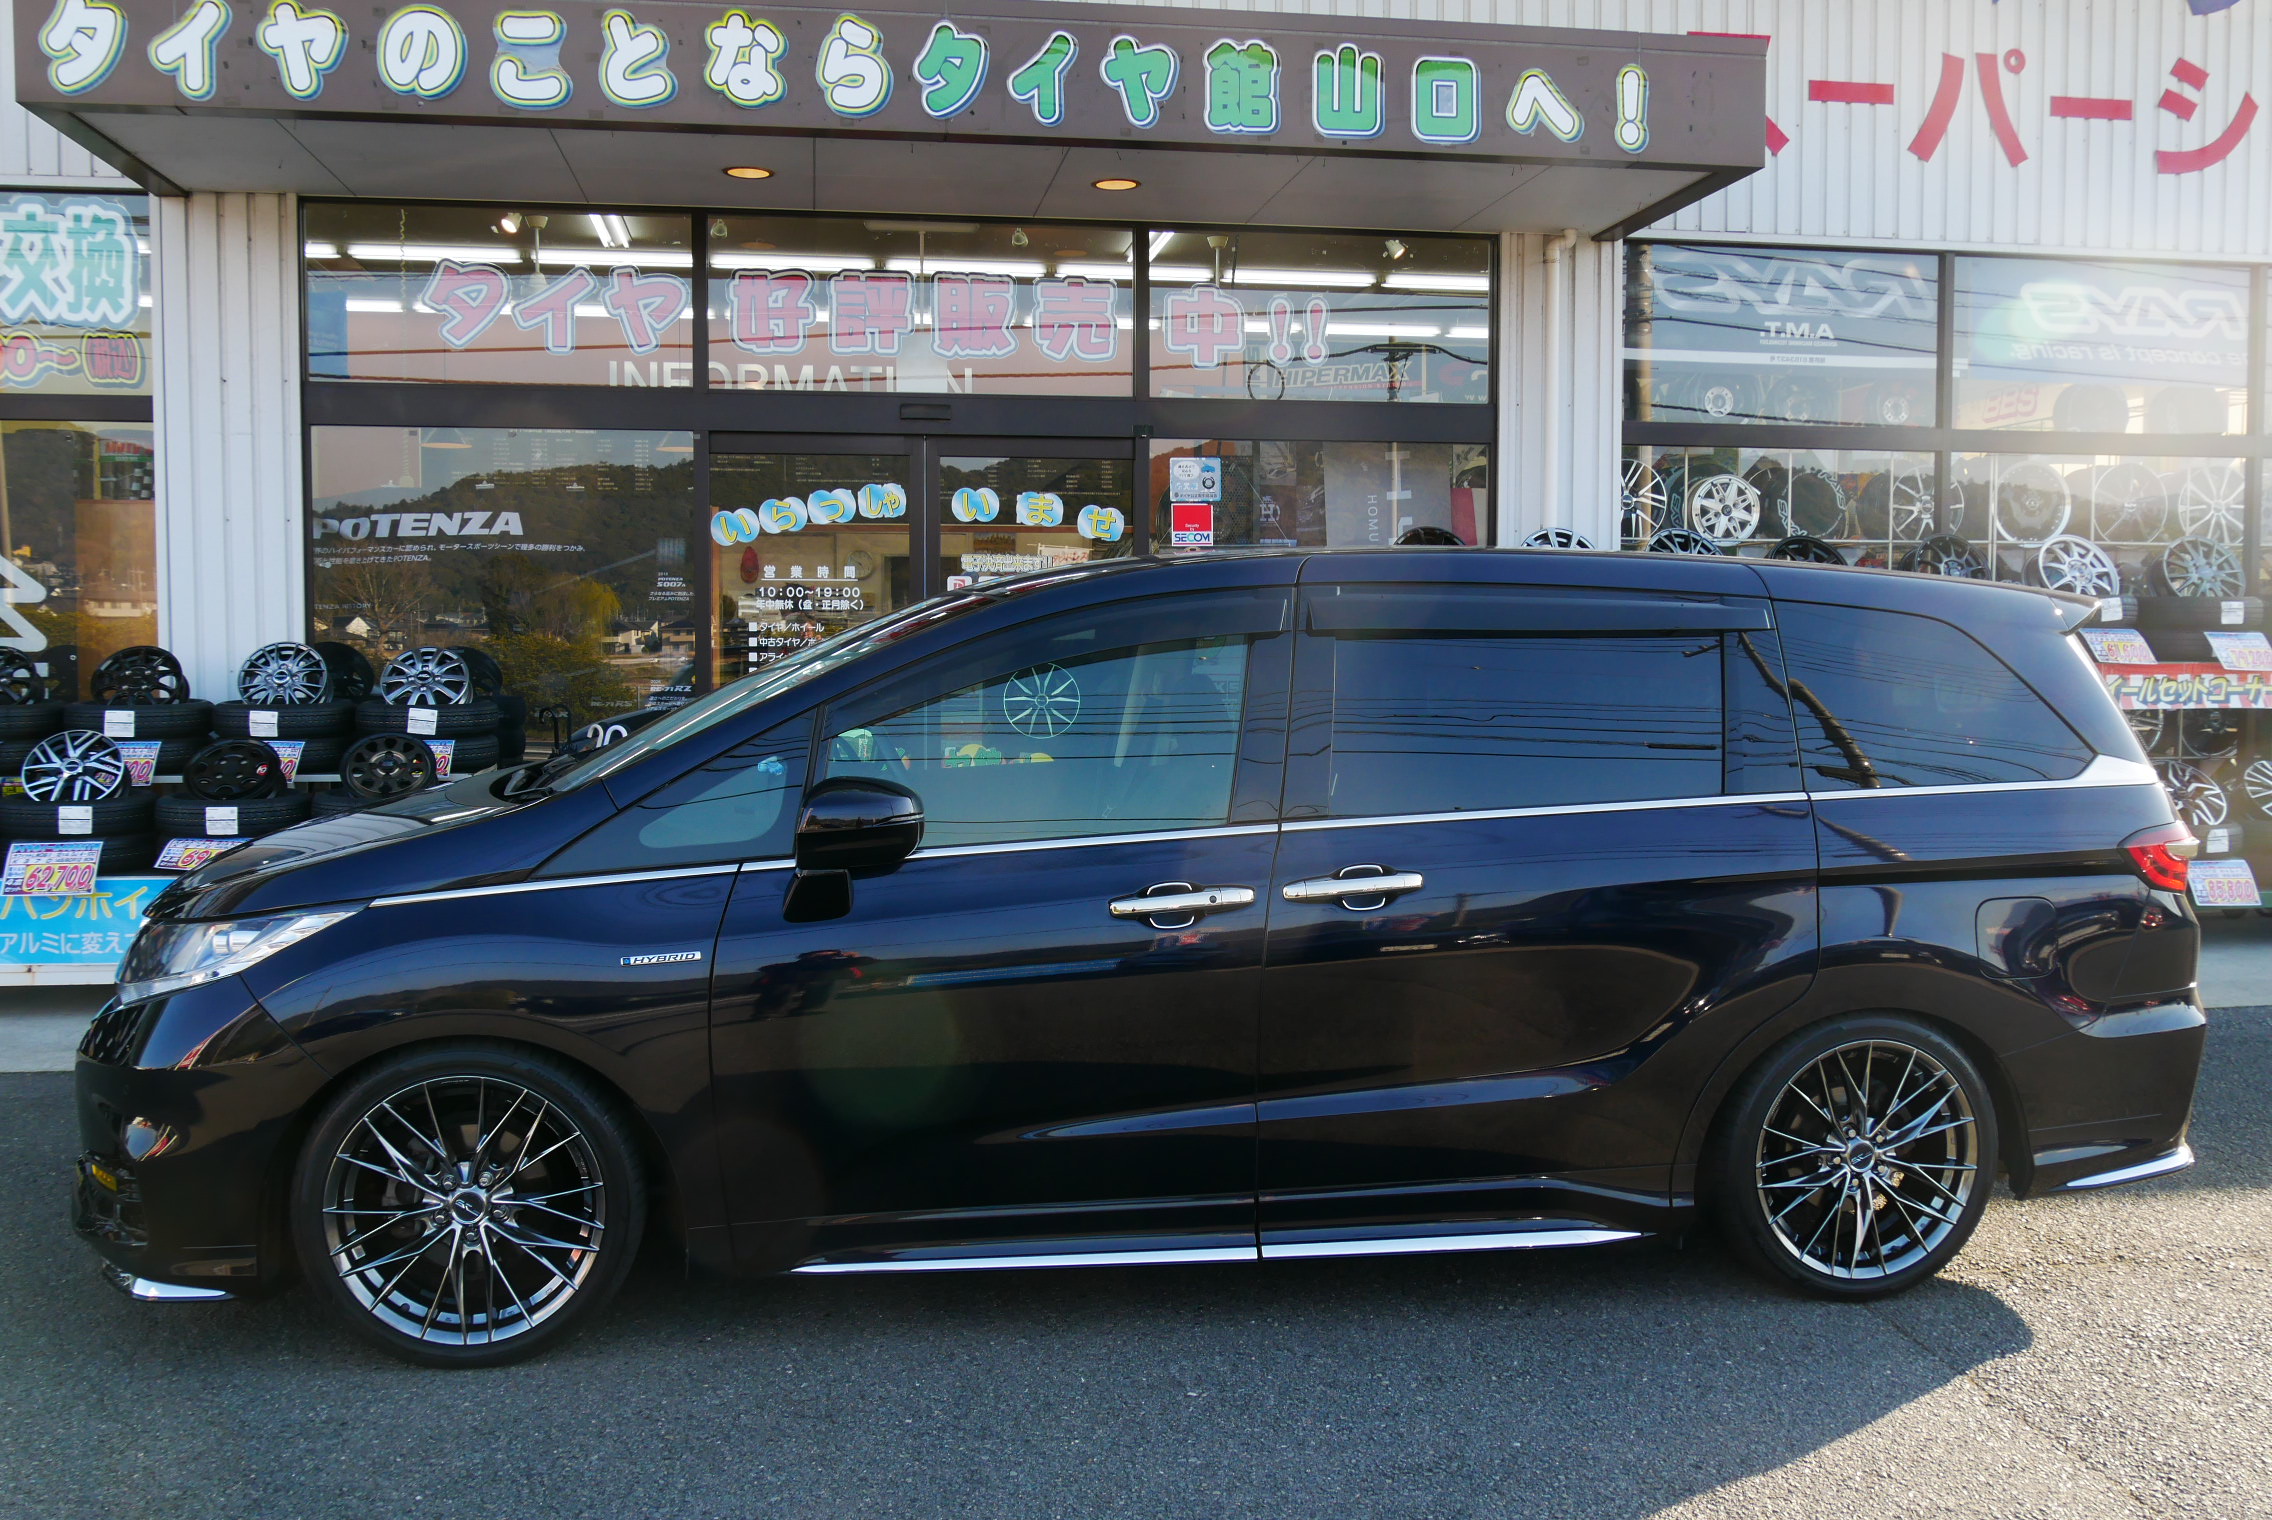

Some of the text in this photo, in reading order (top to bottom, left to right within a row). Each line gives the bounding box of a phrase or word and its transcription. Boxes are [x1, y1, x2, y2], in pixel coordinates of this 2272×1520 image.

[1687, 31, 2259, 175] ーパーシ
[609, 359, 973, 394] INFRMATIN
[1272, 360, 1414, 389] HIPERMAX
[312, 511, 524, 541] POTENZA
[1174, 532, 1211, 543] SECOM
[633, 952, 696, 964] HYBRID
